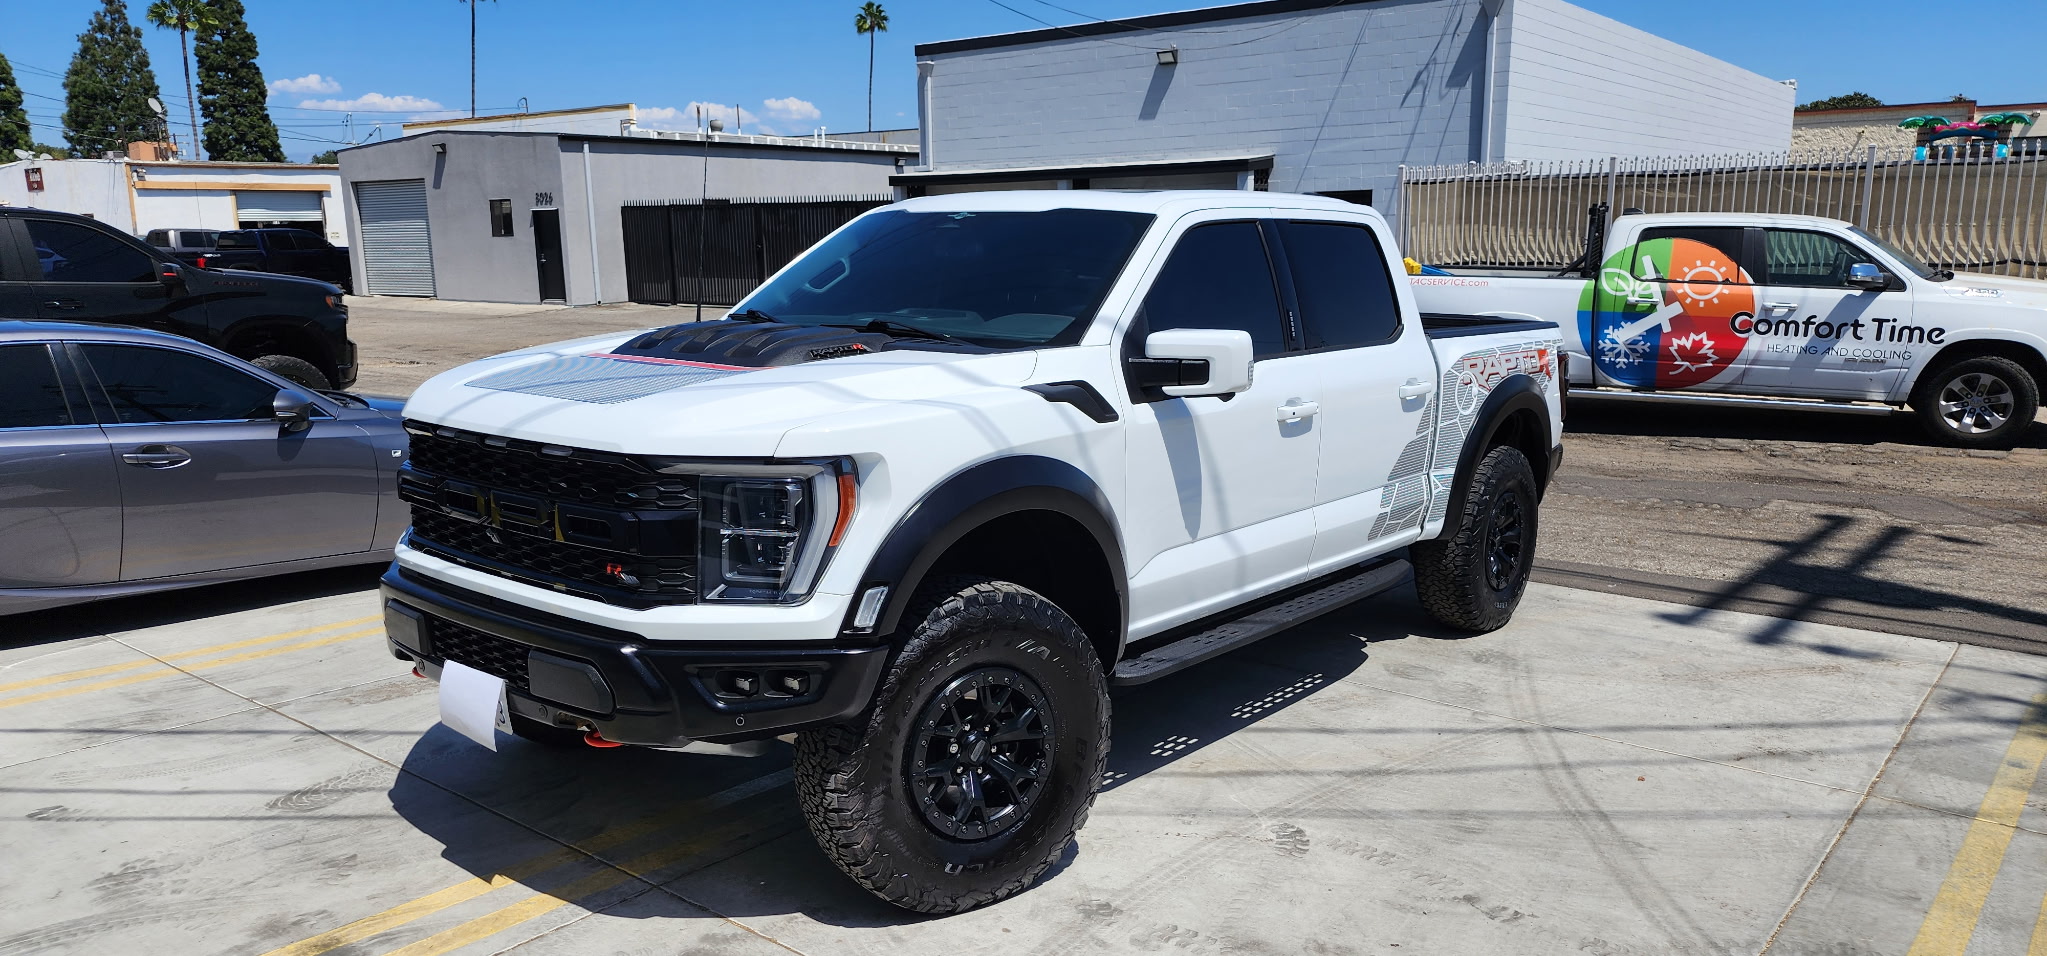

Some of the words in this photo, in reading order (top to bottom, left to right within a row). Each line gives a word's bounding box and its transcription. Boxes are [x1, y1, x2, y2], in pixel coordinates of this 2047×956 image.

[535, 191, 553, 207] 3026
[1730, 311, 1866, 341] Comfort
[1871, 317, 1947, 345] Time
[1767, 343, 1818, 356] HEATING
[1820, 345, 1849, 357] AND
[1852, 348, 1912, 361] COOLING
[1462, 348, 1552, 392] RAPTOR
